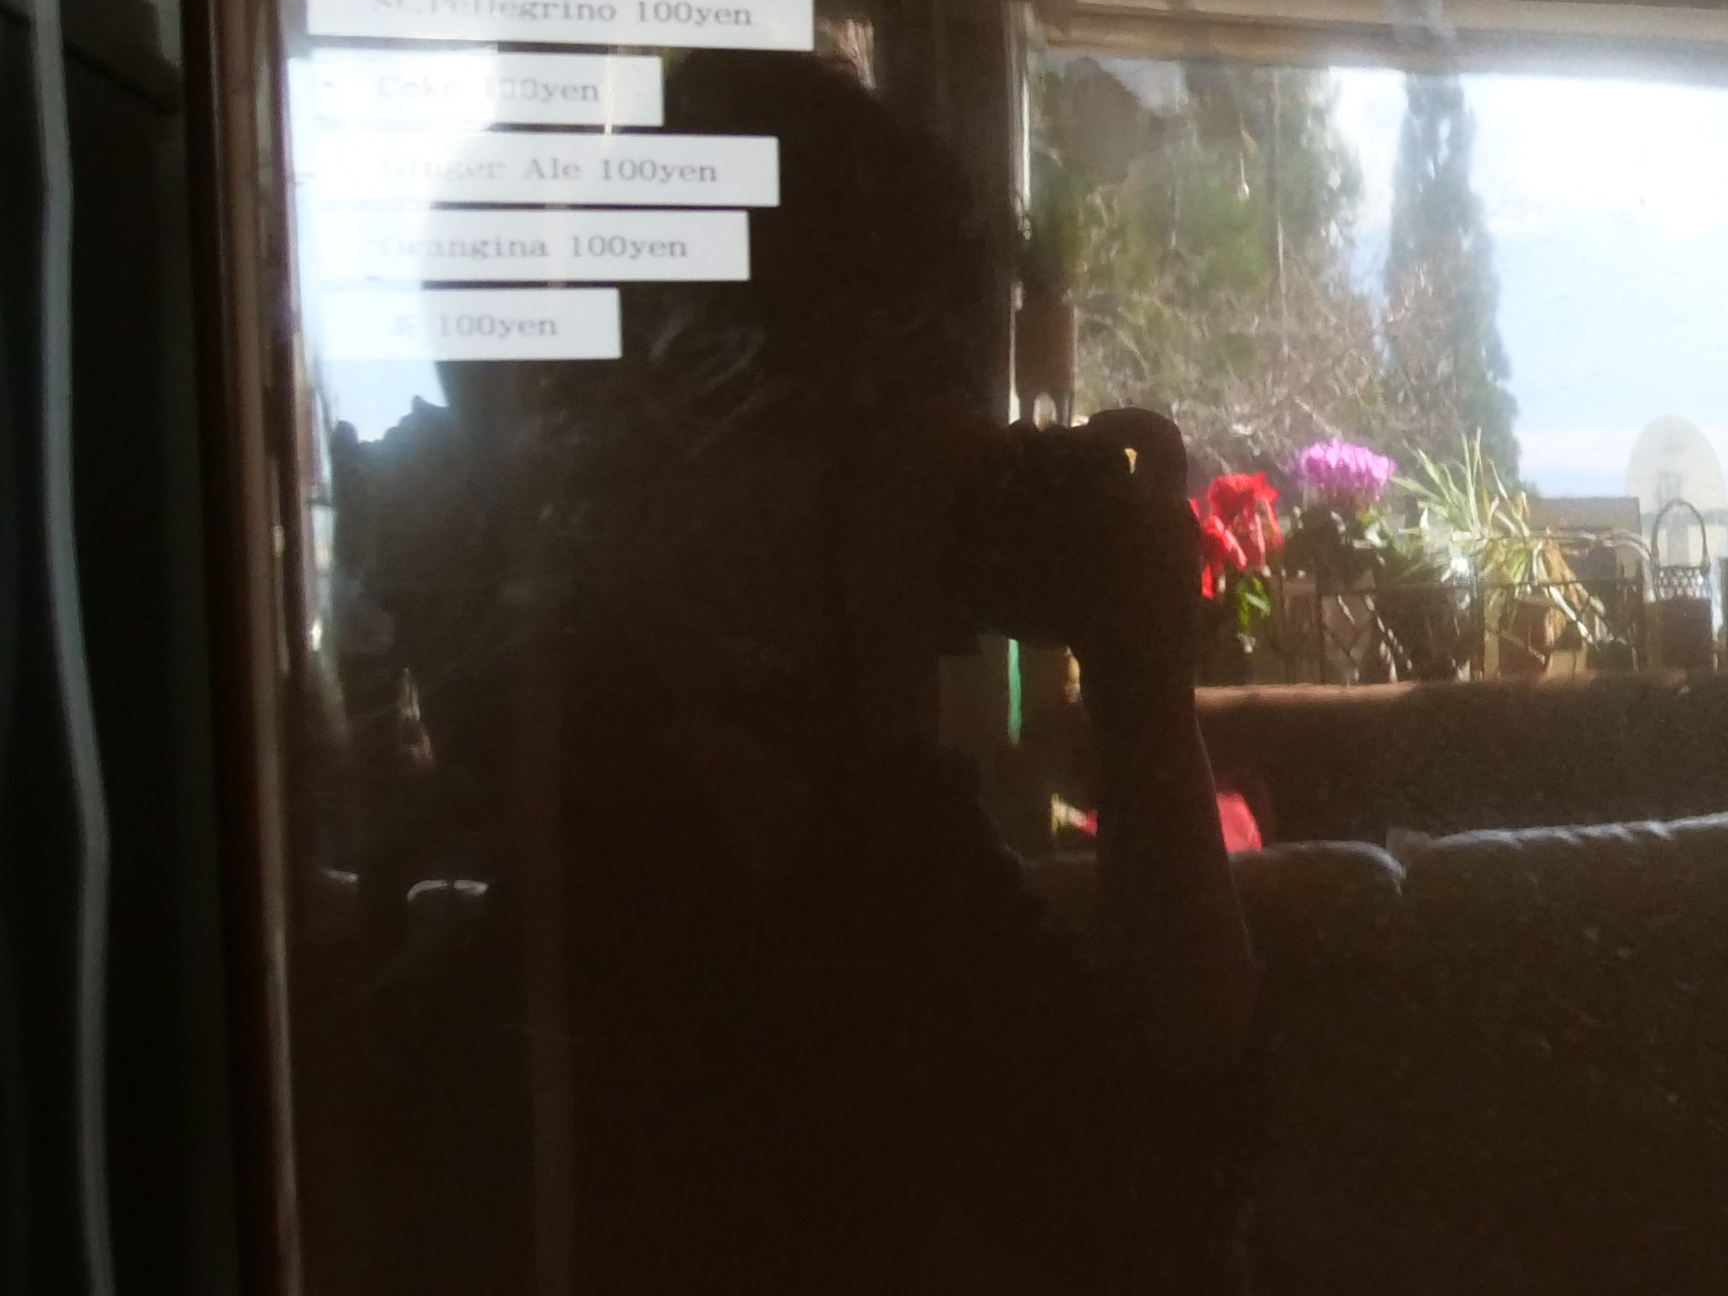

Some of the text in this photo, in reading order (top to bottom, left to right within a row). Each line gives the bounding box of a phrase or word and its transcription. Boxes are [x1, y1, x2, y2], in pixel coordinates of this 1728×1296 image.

[635, 0, 753, 28] 100yen
[377, 76, 601, 104] Coke 100yen
[381, 155, 718, 185] Ginger Ale 100yen
[380, 234, 688, 261] Orangina 100yen
[437, 313, 558, 339] 100yen
